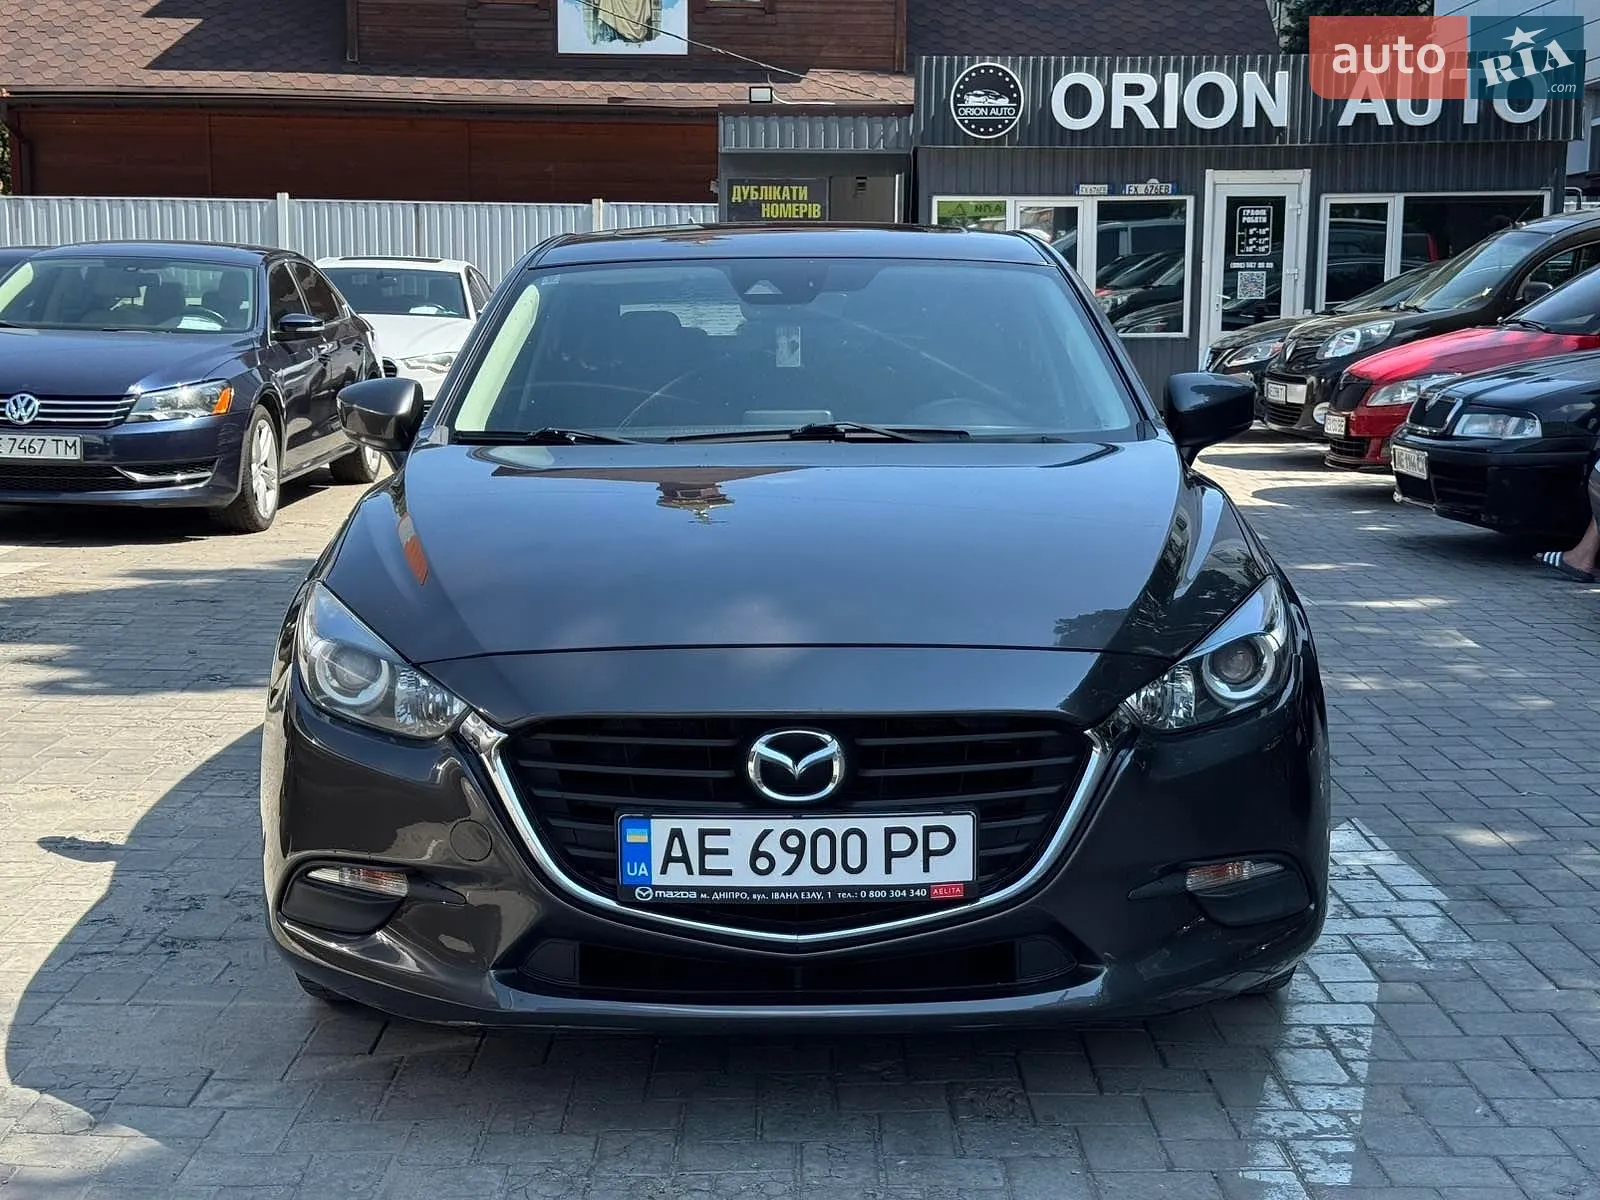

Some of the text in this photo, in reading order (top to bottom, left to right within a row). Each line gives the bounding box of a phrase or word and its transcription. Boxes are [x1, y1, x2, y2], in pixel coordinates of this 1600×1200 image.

[1050, 68, 1548, 131] ORION AUTO
[958, 107, 1016, 116] ORION AUTO
[731, 185, 808, 202] ДУБЛІКАТИ
[761, 203, 822, 218] НОМЕРІВ
[8, 437, 47, 454] 7467
[51, 439, 77, 456] TM
[659, 825, 957, 876] AE 6900 PP
[626, 861, 649, 877] UA
[712, 891, 750, 901] ДНІПРО,
[752, 893, 769, 901] вул.
[771, 891, 799, 899] ІВАНА
[860, 890, 867, 898] 0
[868, 890, 887, 898] 800
[890, 889, 907, 897] 304
[909, 888, 927, 897] 340
[932, 886, 962, 896] AELITA
